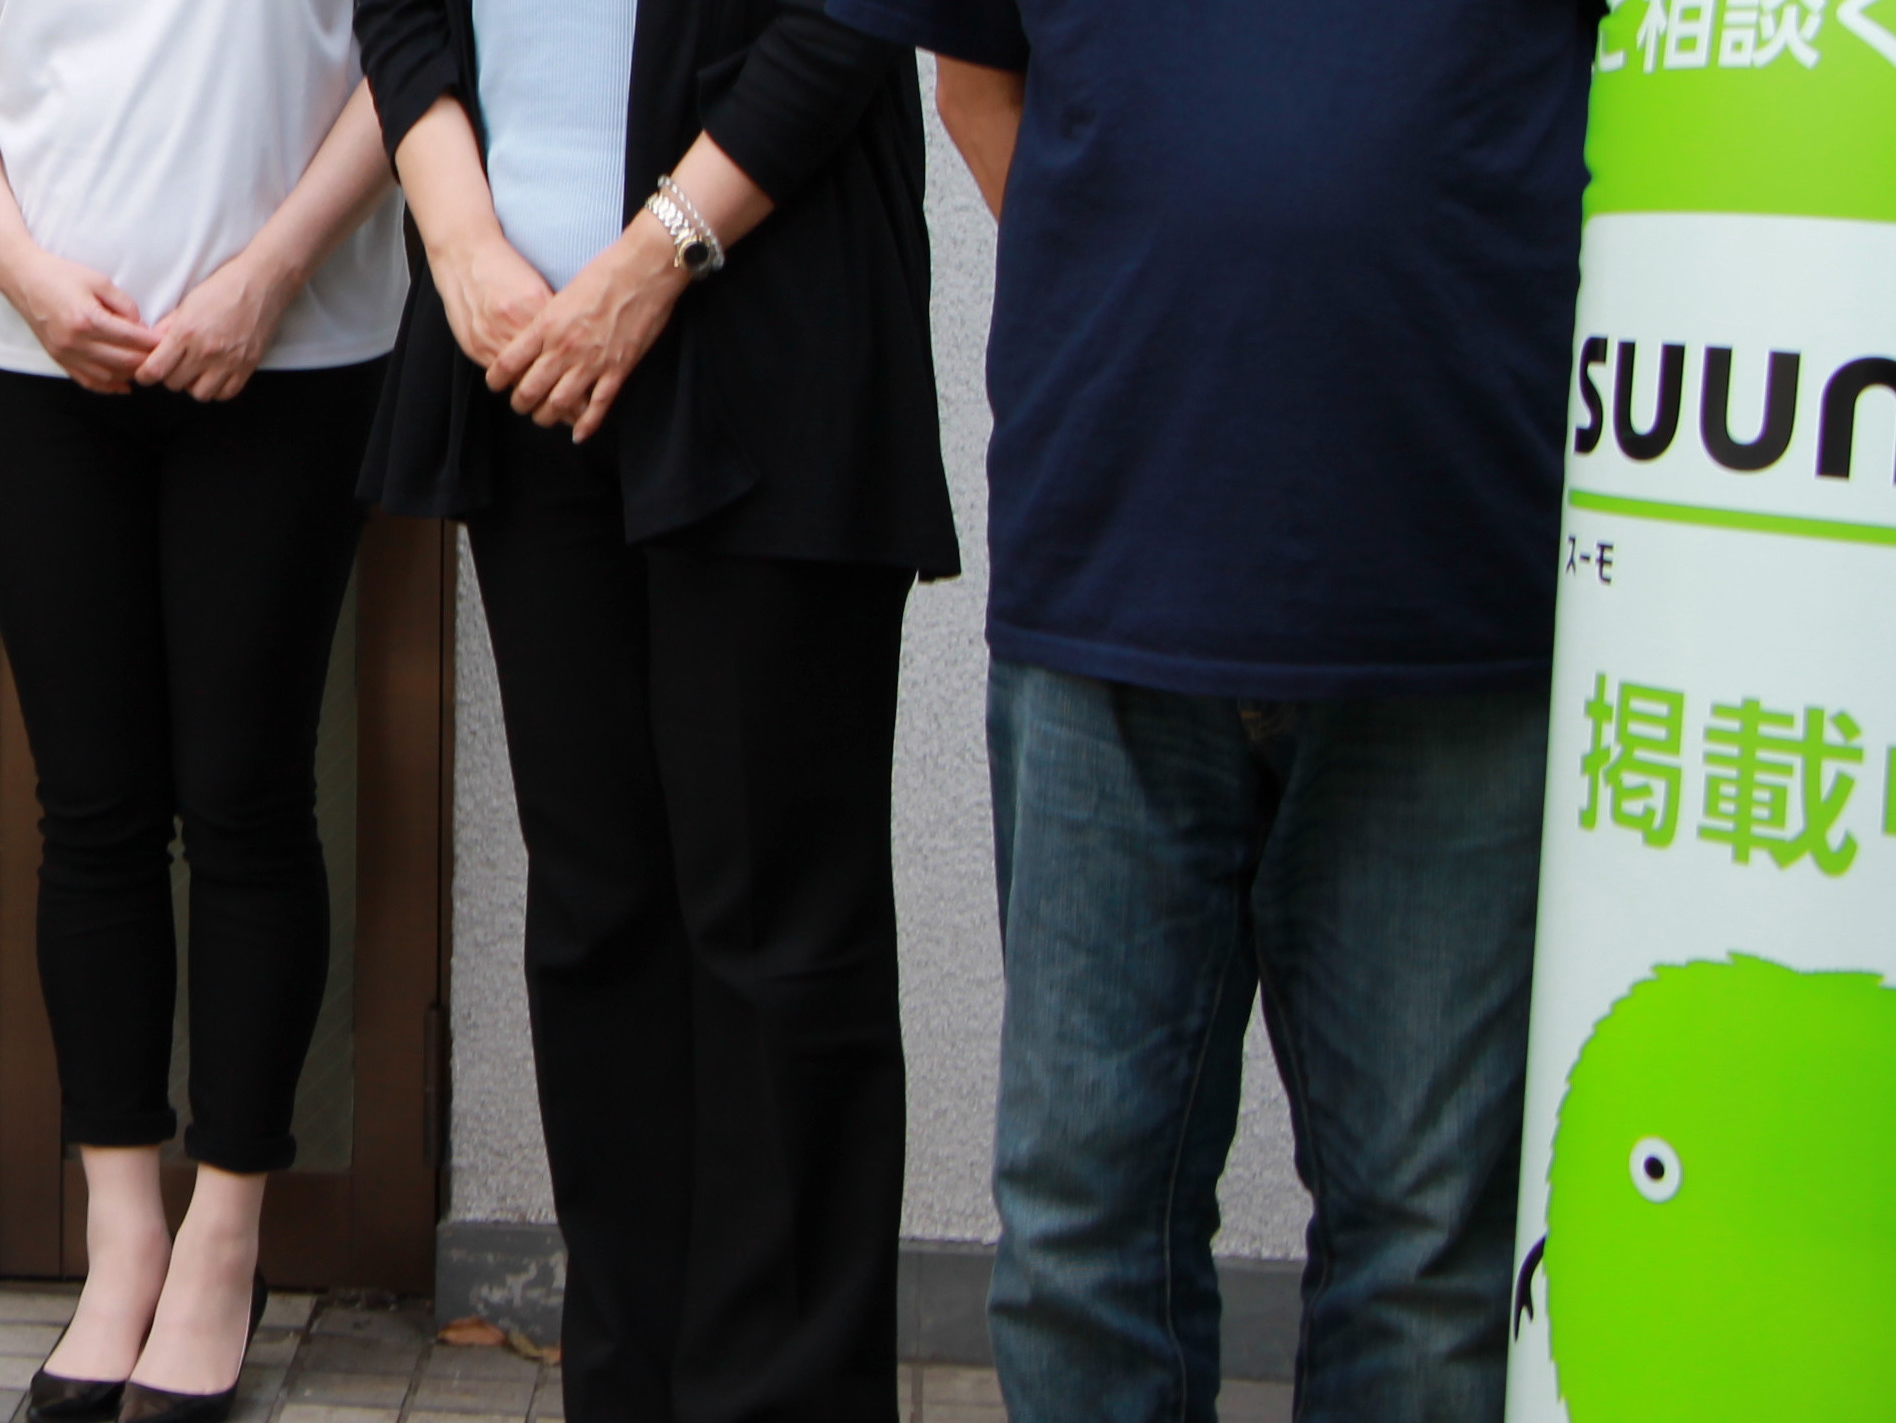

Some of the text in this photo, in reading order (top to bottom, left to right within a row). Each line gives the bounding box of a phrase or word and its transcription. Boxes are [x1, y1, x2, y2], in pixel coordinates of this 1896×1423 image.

[1566, 535, 1615, 585] スーモ
[1578, 671, 1896, 878] 掲載
